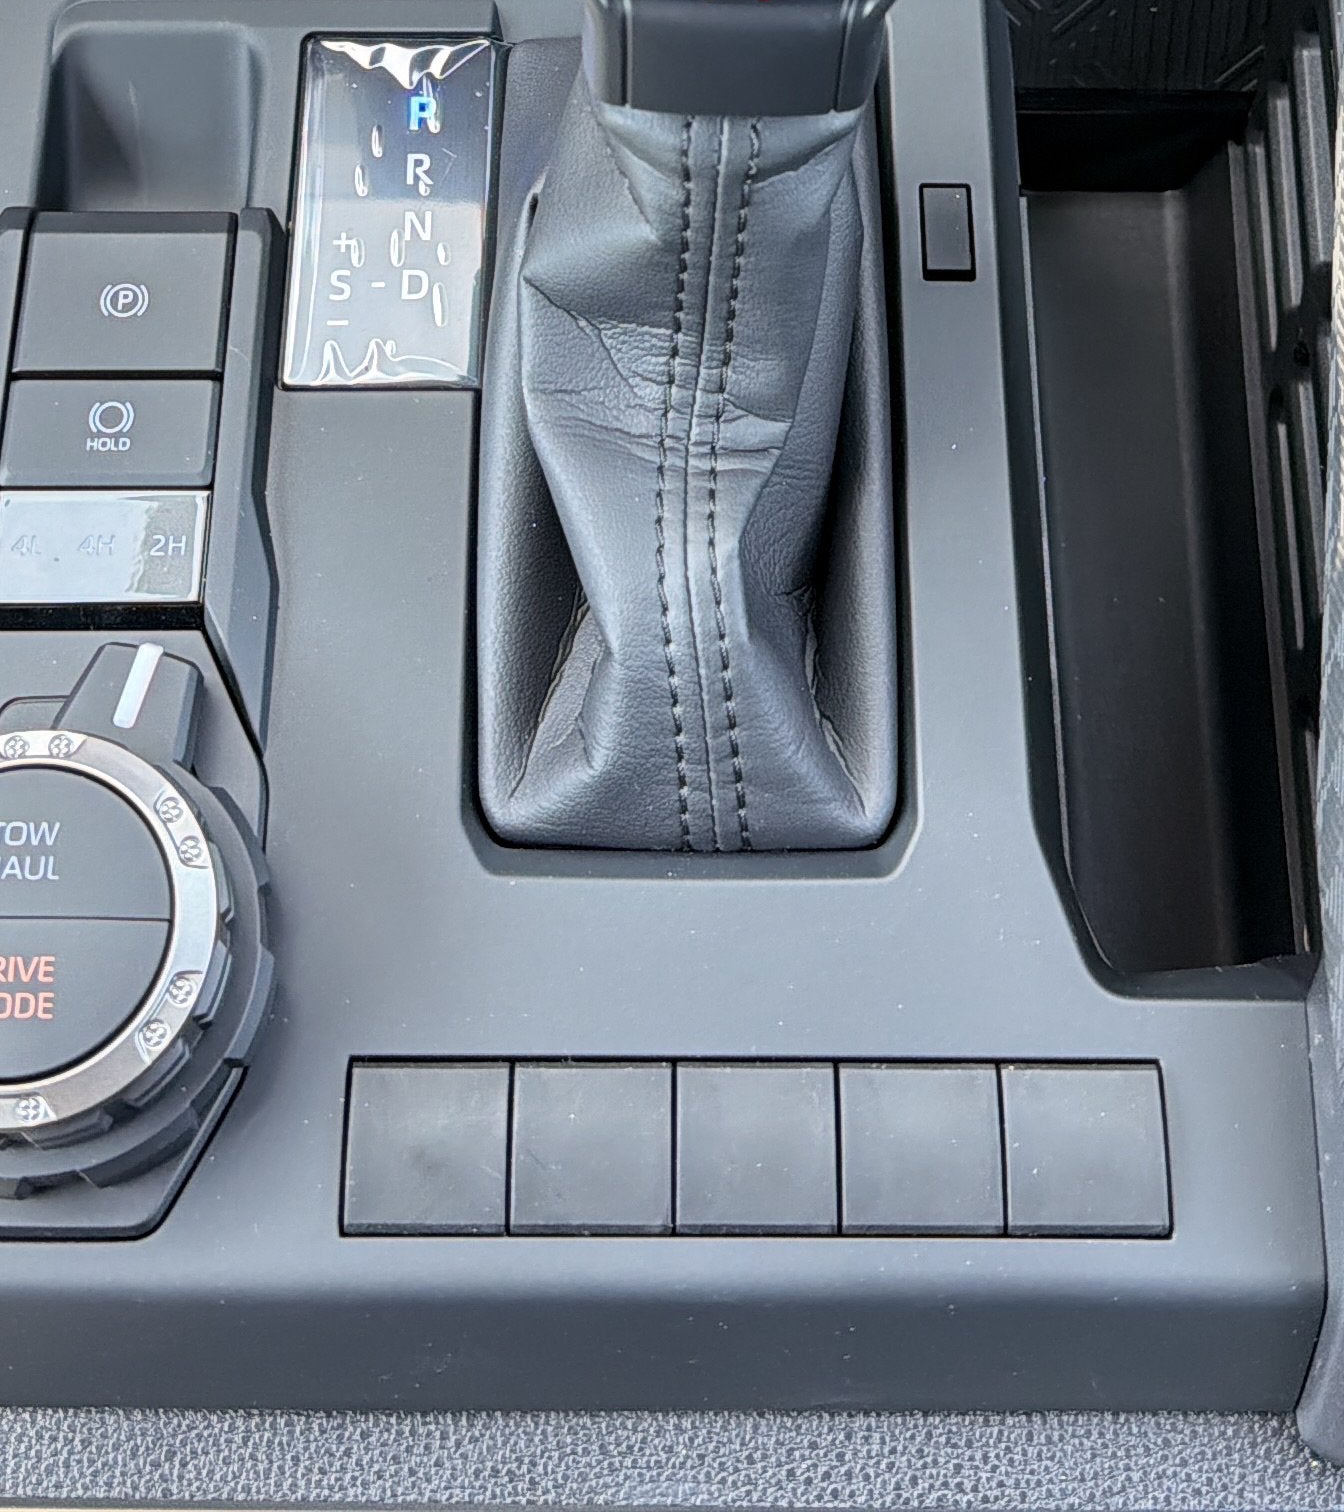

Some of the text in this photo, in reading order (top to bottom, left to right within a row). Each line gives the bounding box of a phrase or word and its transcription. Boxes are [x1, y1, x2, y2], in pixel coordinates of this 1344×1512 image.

[408, 96, 438, 132] P
[406, 154, 434, 185] R
[404, 211, 432, 241] N
[329, 269, 429, 301] S D
[86, 438, 131, 452] HOLD
[10, 534, 187, 556] 4L 4H 2H
